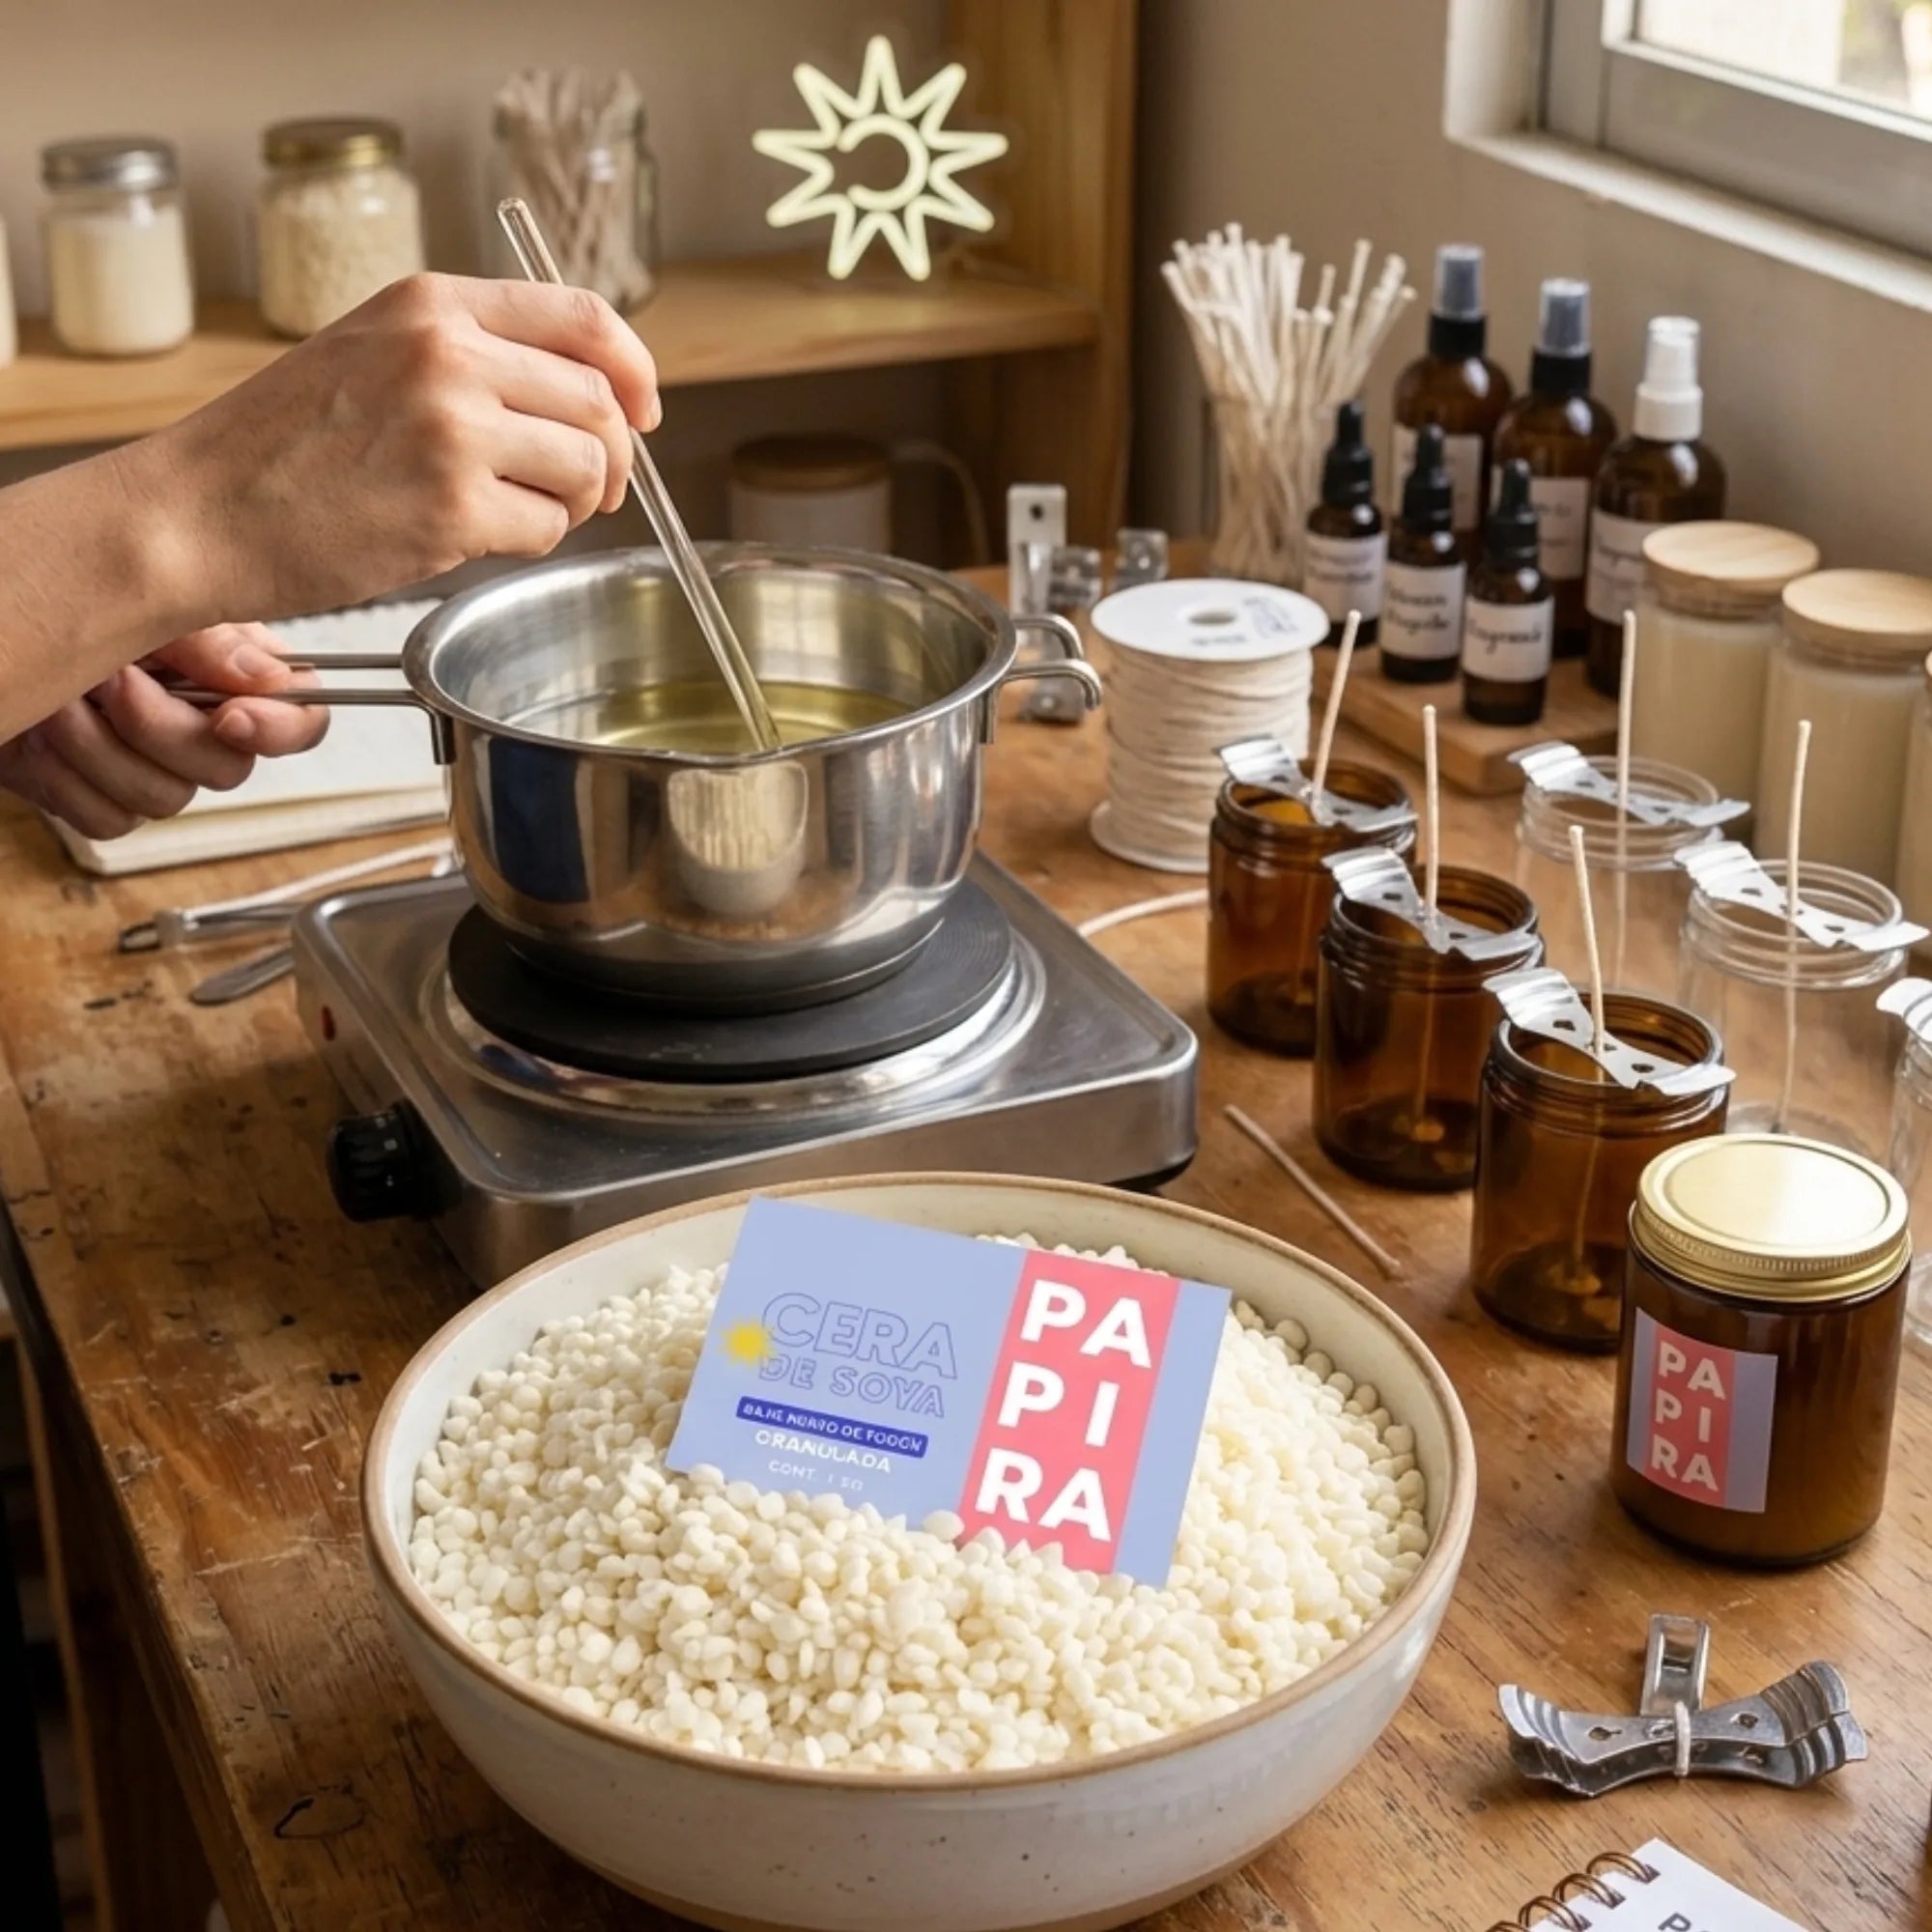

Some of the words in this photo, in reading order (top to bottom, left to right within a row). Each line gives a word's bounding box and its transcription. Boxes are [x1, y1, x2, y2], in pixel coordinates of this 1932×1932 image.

[761, 1293, 957, 1379] CERA
[1021, 1279, 1151, 1368] PA
[758, 1352, 817, 1390] DE
[830, 1366, 944, 1418] SOYA
[1659, 1341, 1726, 1400] PA
[975, 1448, 1111, 1543] RA
[1651, 1434, 1719, 1492] RA
